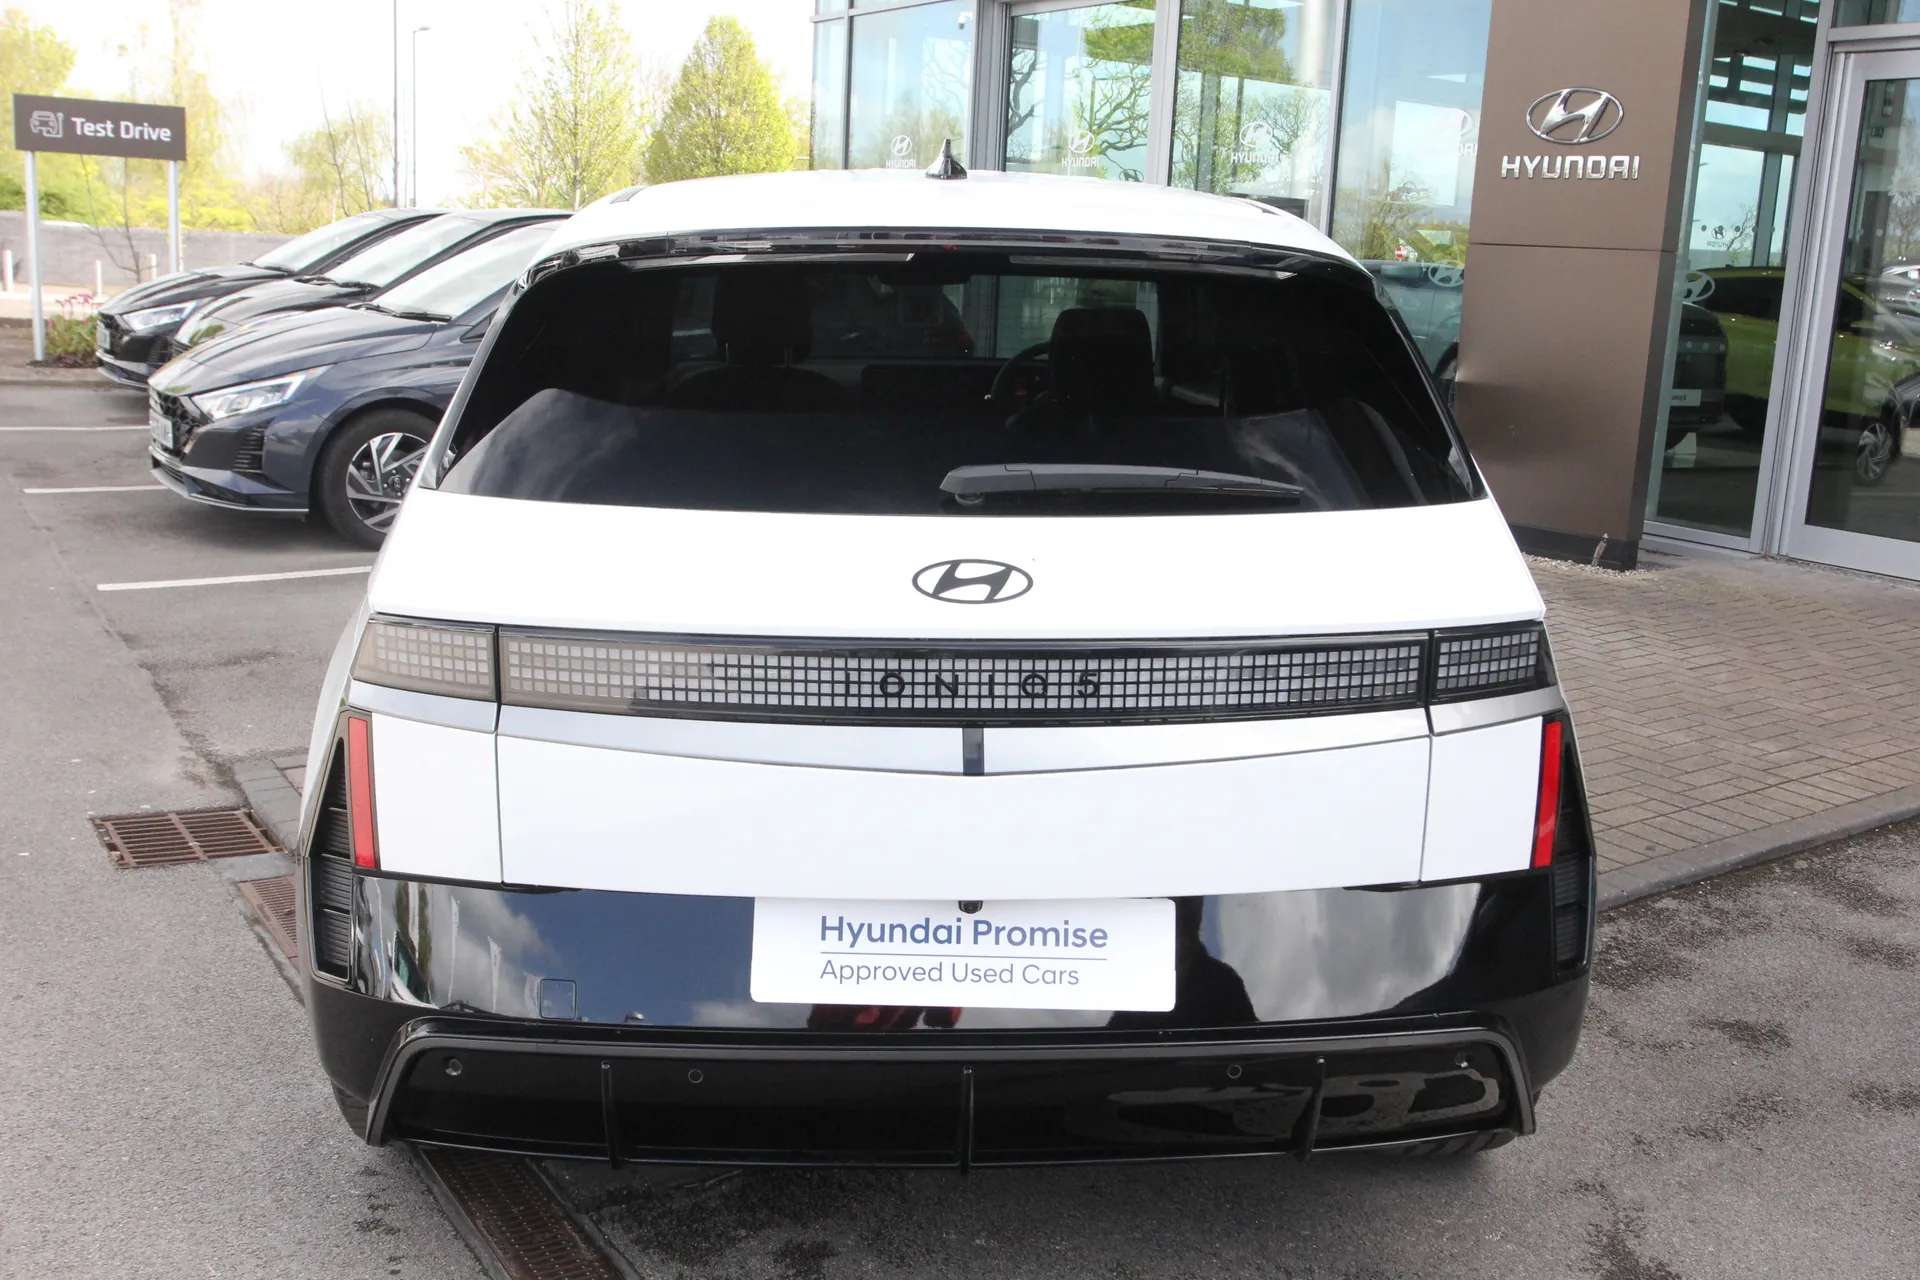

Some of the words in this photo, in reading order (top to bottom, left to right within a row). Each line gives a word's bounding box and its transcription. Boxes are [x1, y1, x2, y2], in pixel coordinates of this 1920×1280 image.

[71, 116, 114, 138] Test
[120, 121, 172, 142] Drive
[1500, 155, 1640, 180] HYUNDAI
[845, 672, 1048, 698] IONIQ
[820, 916, 963, 948] Hyundai
[973, 919, 1109, 948] Promise
[819, 960, 944, 984] Approved
[951, 963, 1015, 984] Used
[1022, 966, 1080, 986] Cars
